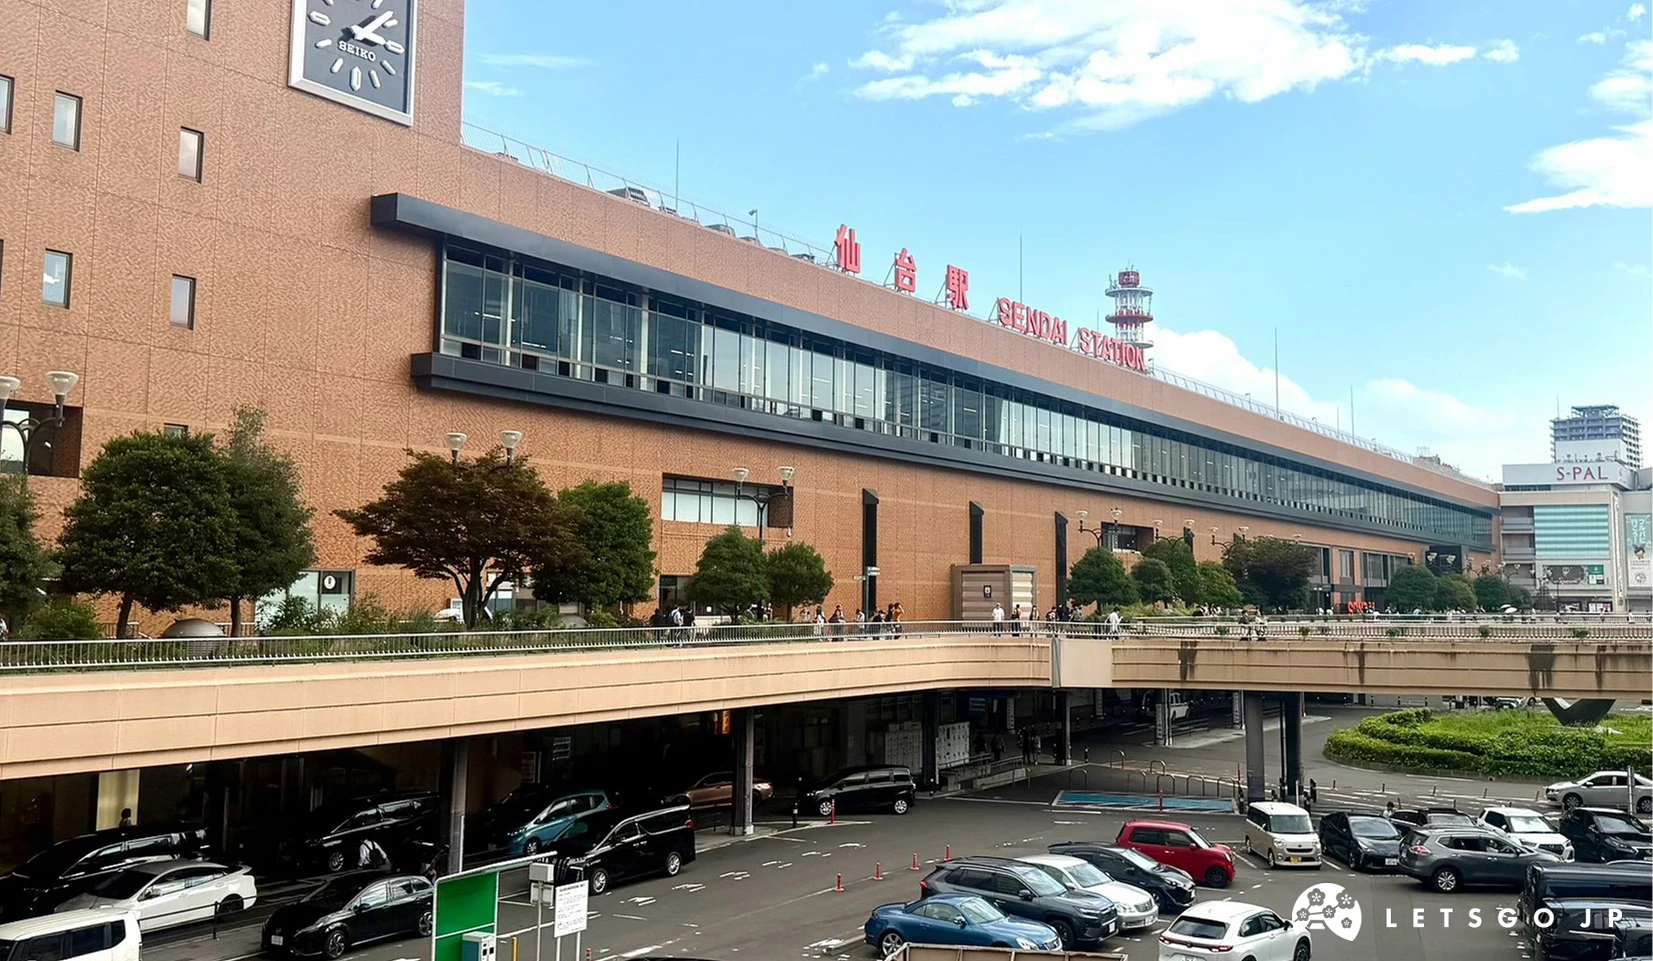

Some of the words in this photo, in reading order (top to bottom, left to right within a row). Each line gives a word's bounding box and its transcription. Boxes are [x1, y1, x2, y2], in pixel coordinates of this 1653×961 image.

[338, 40, 376, 62] SEIKO
[834, 224, 969, 310] 仙台駅
[997, 297, 1068, 345] SENDAI
[1080, 327, 1146, 372] STATION
[1556, 466, 1608, 481] S-PAL
